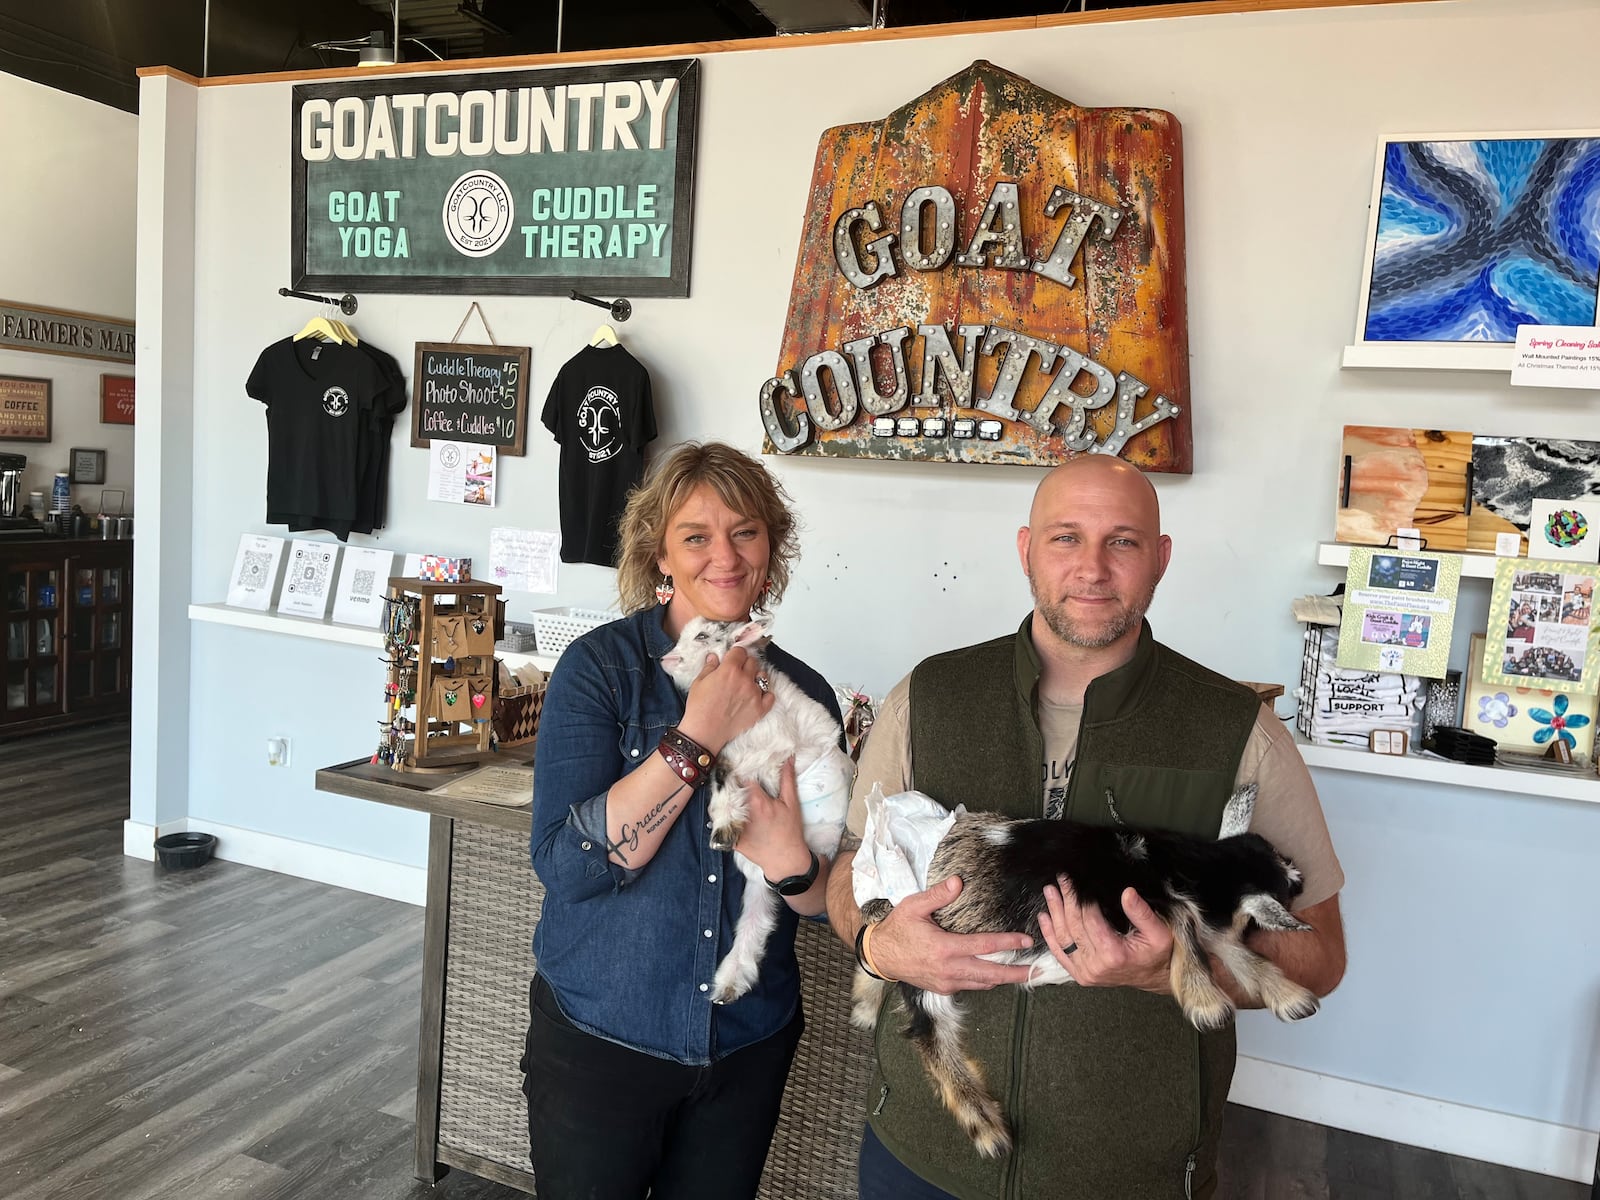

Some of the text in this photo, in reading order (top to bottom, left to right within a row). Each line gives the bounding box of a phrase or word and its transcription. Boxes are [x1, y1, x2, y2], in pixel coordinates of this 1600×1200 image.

[301, 78, 680, 161] GOATCOUNTRY
[329, 190, 401, 223] GOAT
[496, 192, 506, 212] LLC
[532, 184, 658, 222] CUDDLE
[338, 226, 411, 258] YOGA
[474, 237, 492, 247] 2021
[521, 223, 668, 259] THERAPY
[833, 181, 1124, 290] GOAT
[2, 314, 93, 349] FARMER'S
[1529, 338, 1553, 349] Spring
[1555, 339, 1586, 350] Cleaning
[428, 356, 465, 376] Cuddle
[464, 357, 502, 388] Therapy
[4, 400, 39, 411] COFFEE
[425, 380, 457, 404] Photo
[459, 380, 499, 405] Shoot
[759, 324, 1181, 457] COUNTRY
[424, 408, 454, 432] Coffee
[460, 412, 496, 435] Cuddles
[1334, 702, 1385, 712] SUPPORT
[622, 803, 663, 851] Grace
